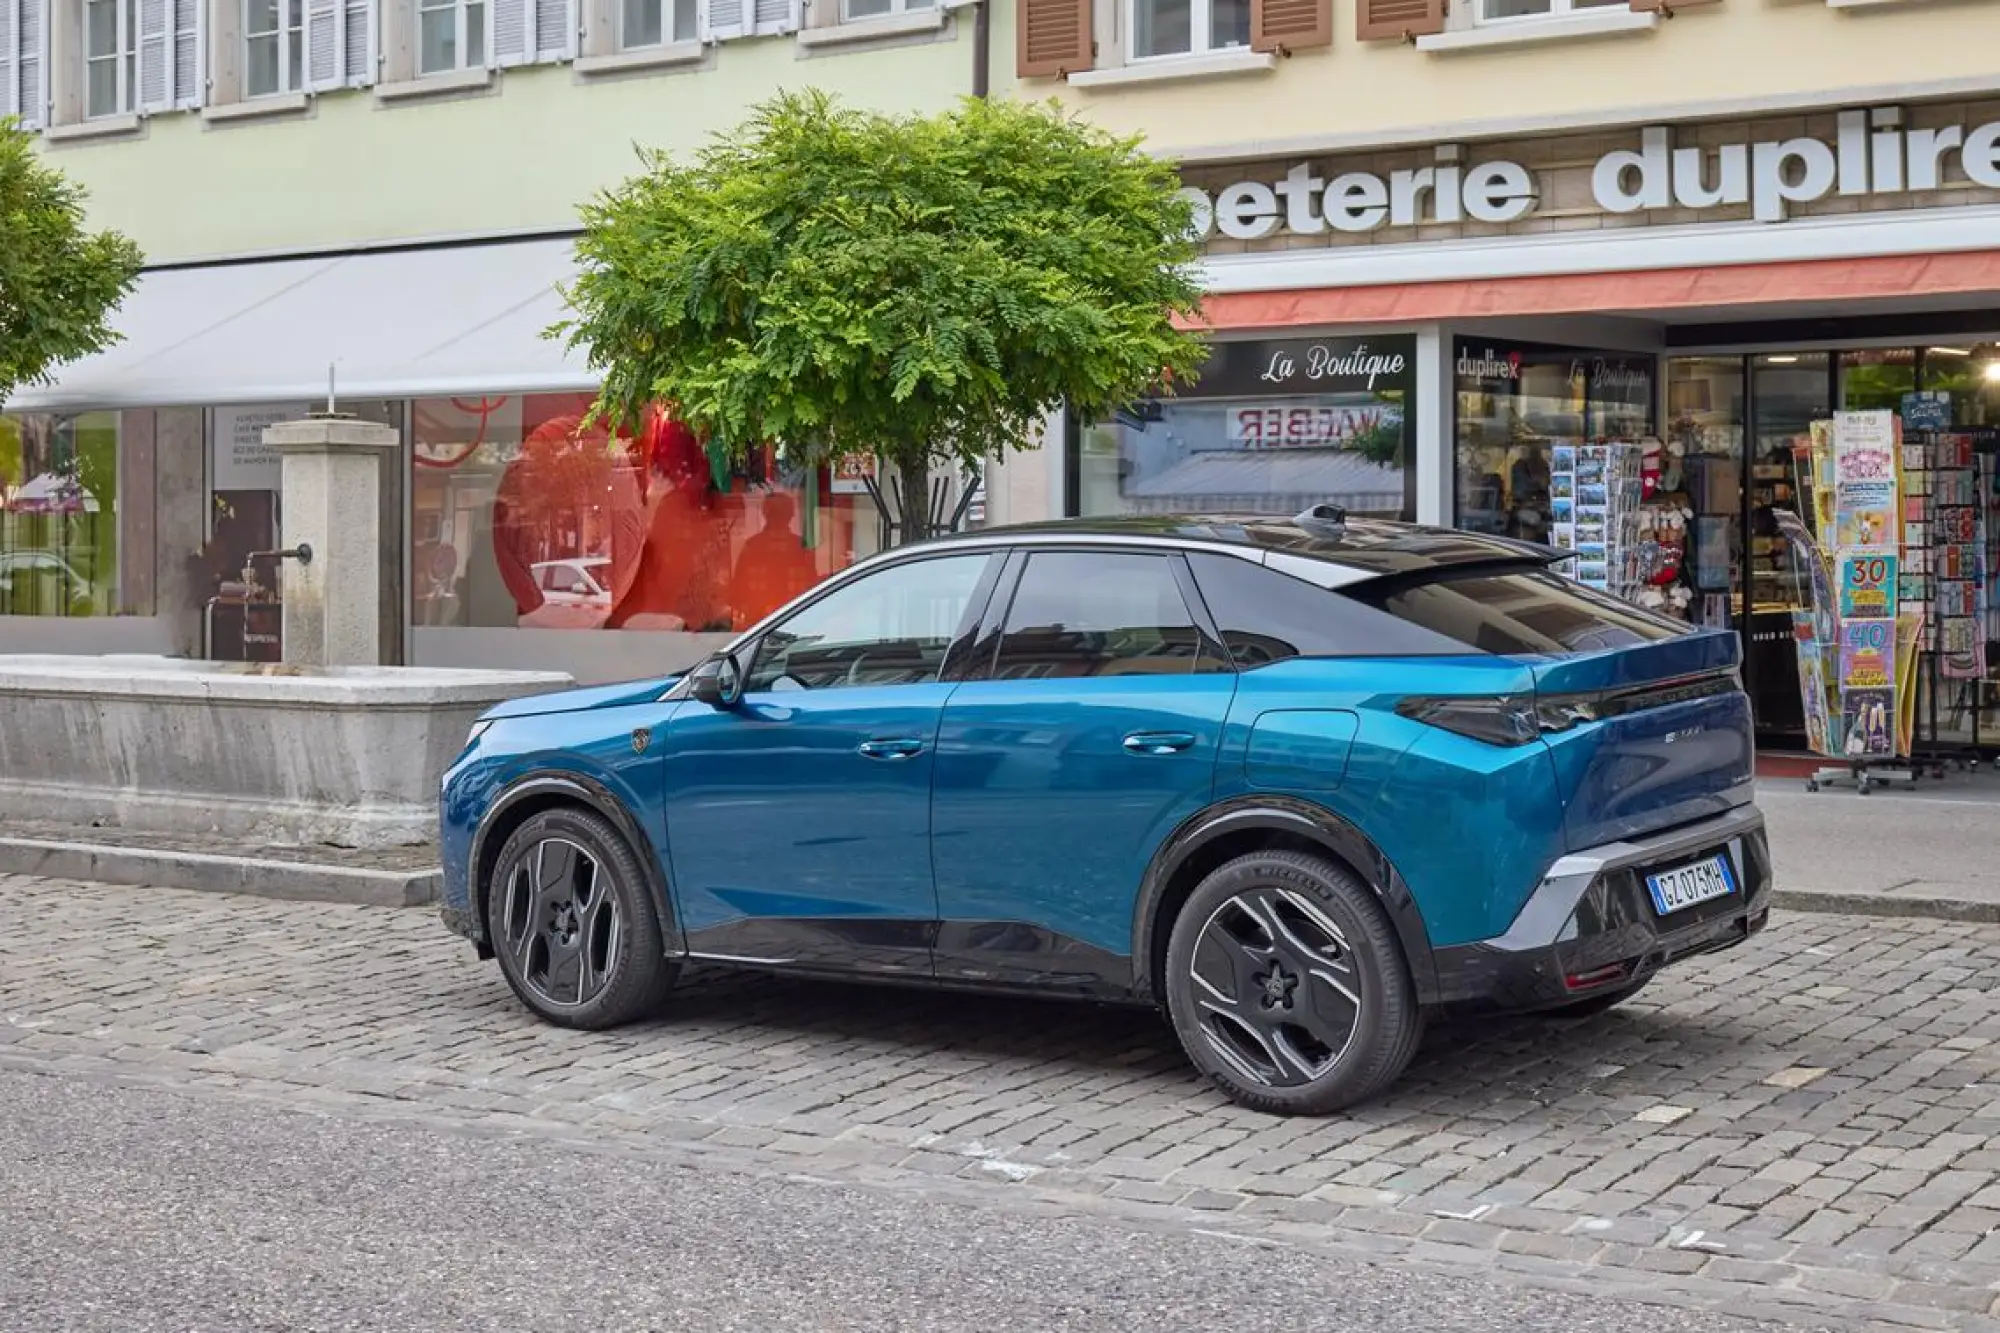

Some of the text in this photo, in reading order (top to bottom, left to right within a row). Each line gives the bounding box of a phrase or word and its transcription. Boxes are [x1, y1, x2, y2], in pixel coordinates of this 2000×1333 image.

[1261, 345, 1404, 390] La Boutique
[1457, 346, 1519, 386] duplirex
[1851, 558, 1885, 584] 30
[1849, 623, 1885, 648] 40
